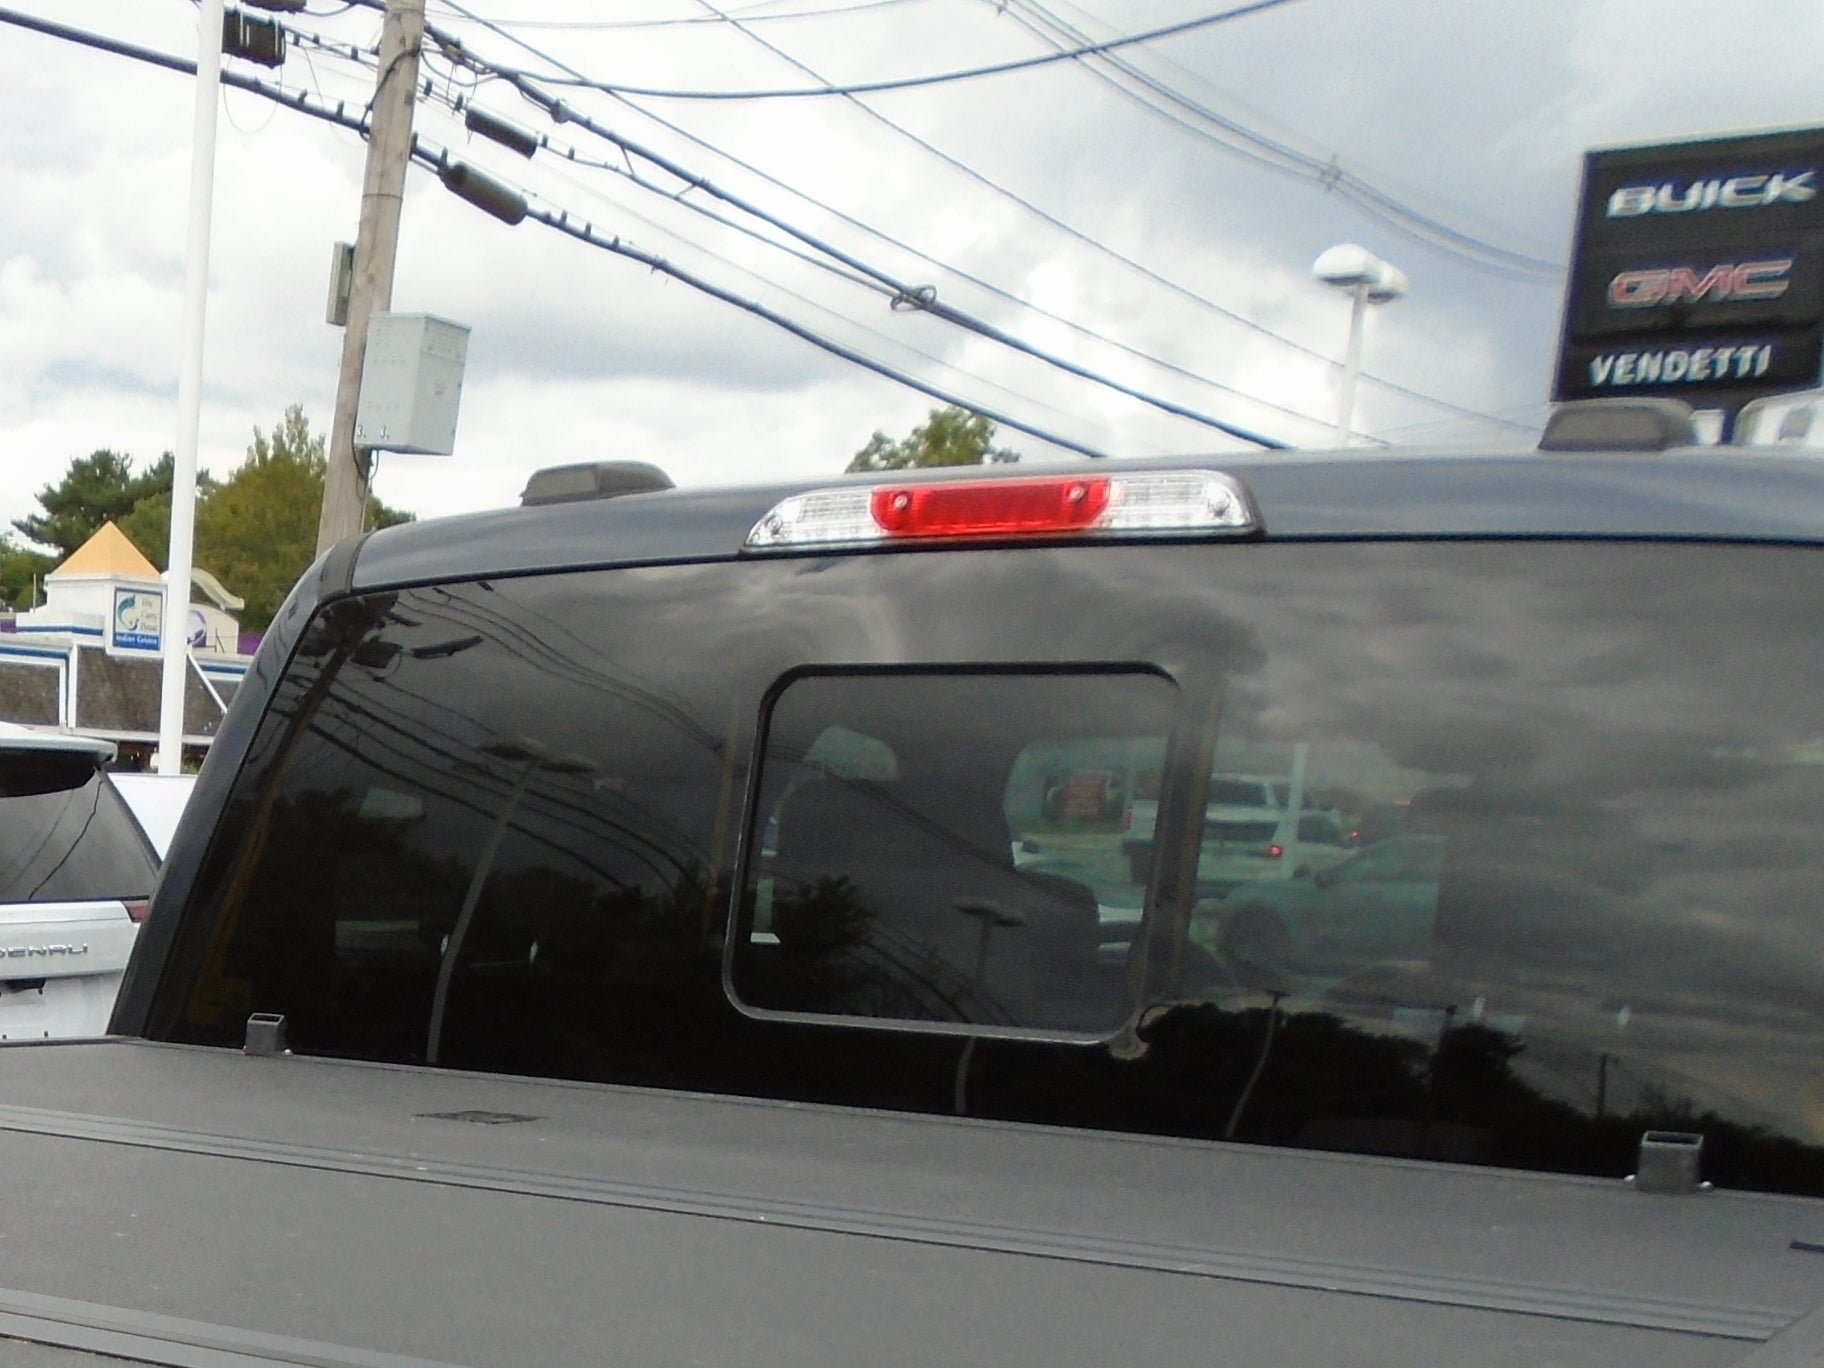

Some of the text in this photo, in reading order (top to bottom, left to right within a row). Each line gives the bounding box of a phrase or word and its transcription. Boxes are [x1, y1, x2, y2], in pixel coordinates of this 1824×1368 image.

[1606, 170, 1818, 218] BUICK
[1607, 258, 1792, 308] GMC
[1589, 345, 1772, 386] VENDETTI
